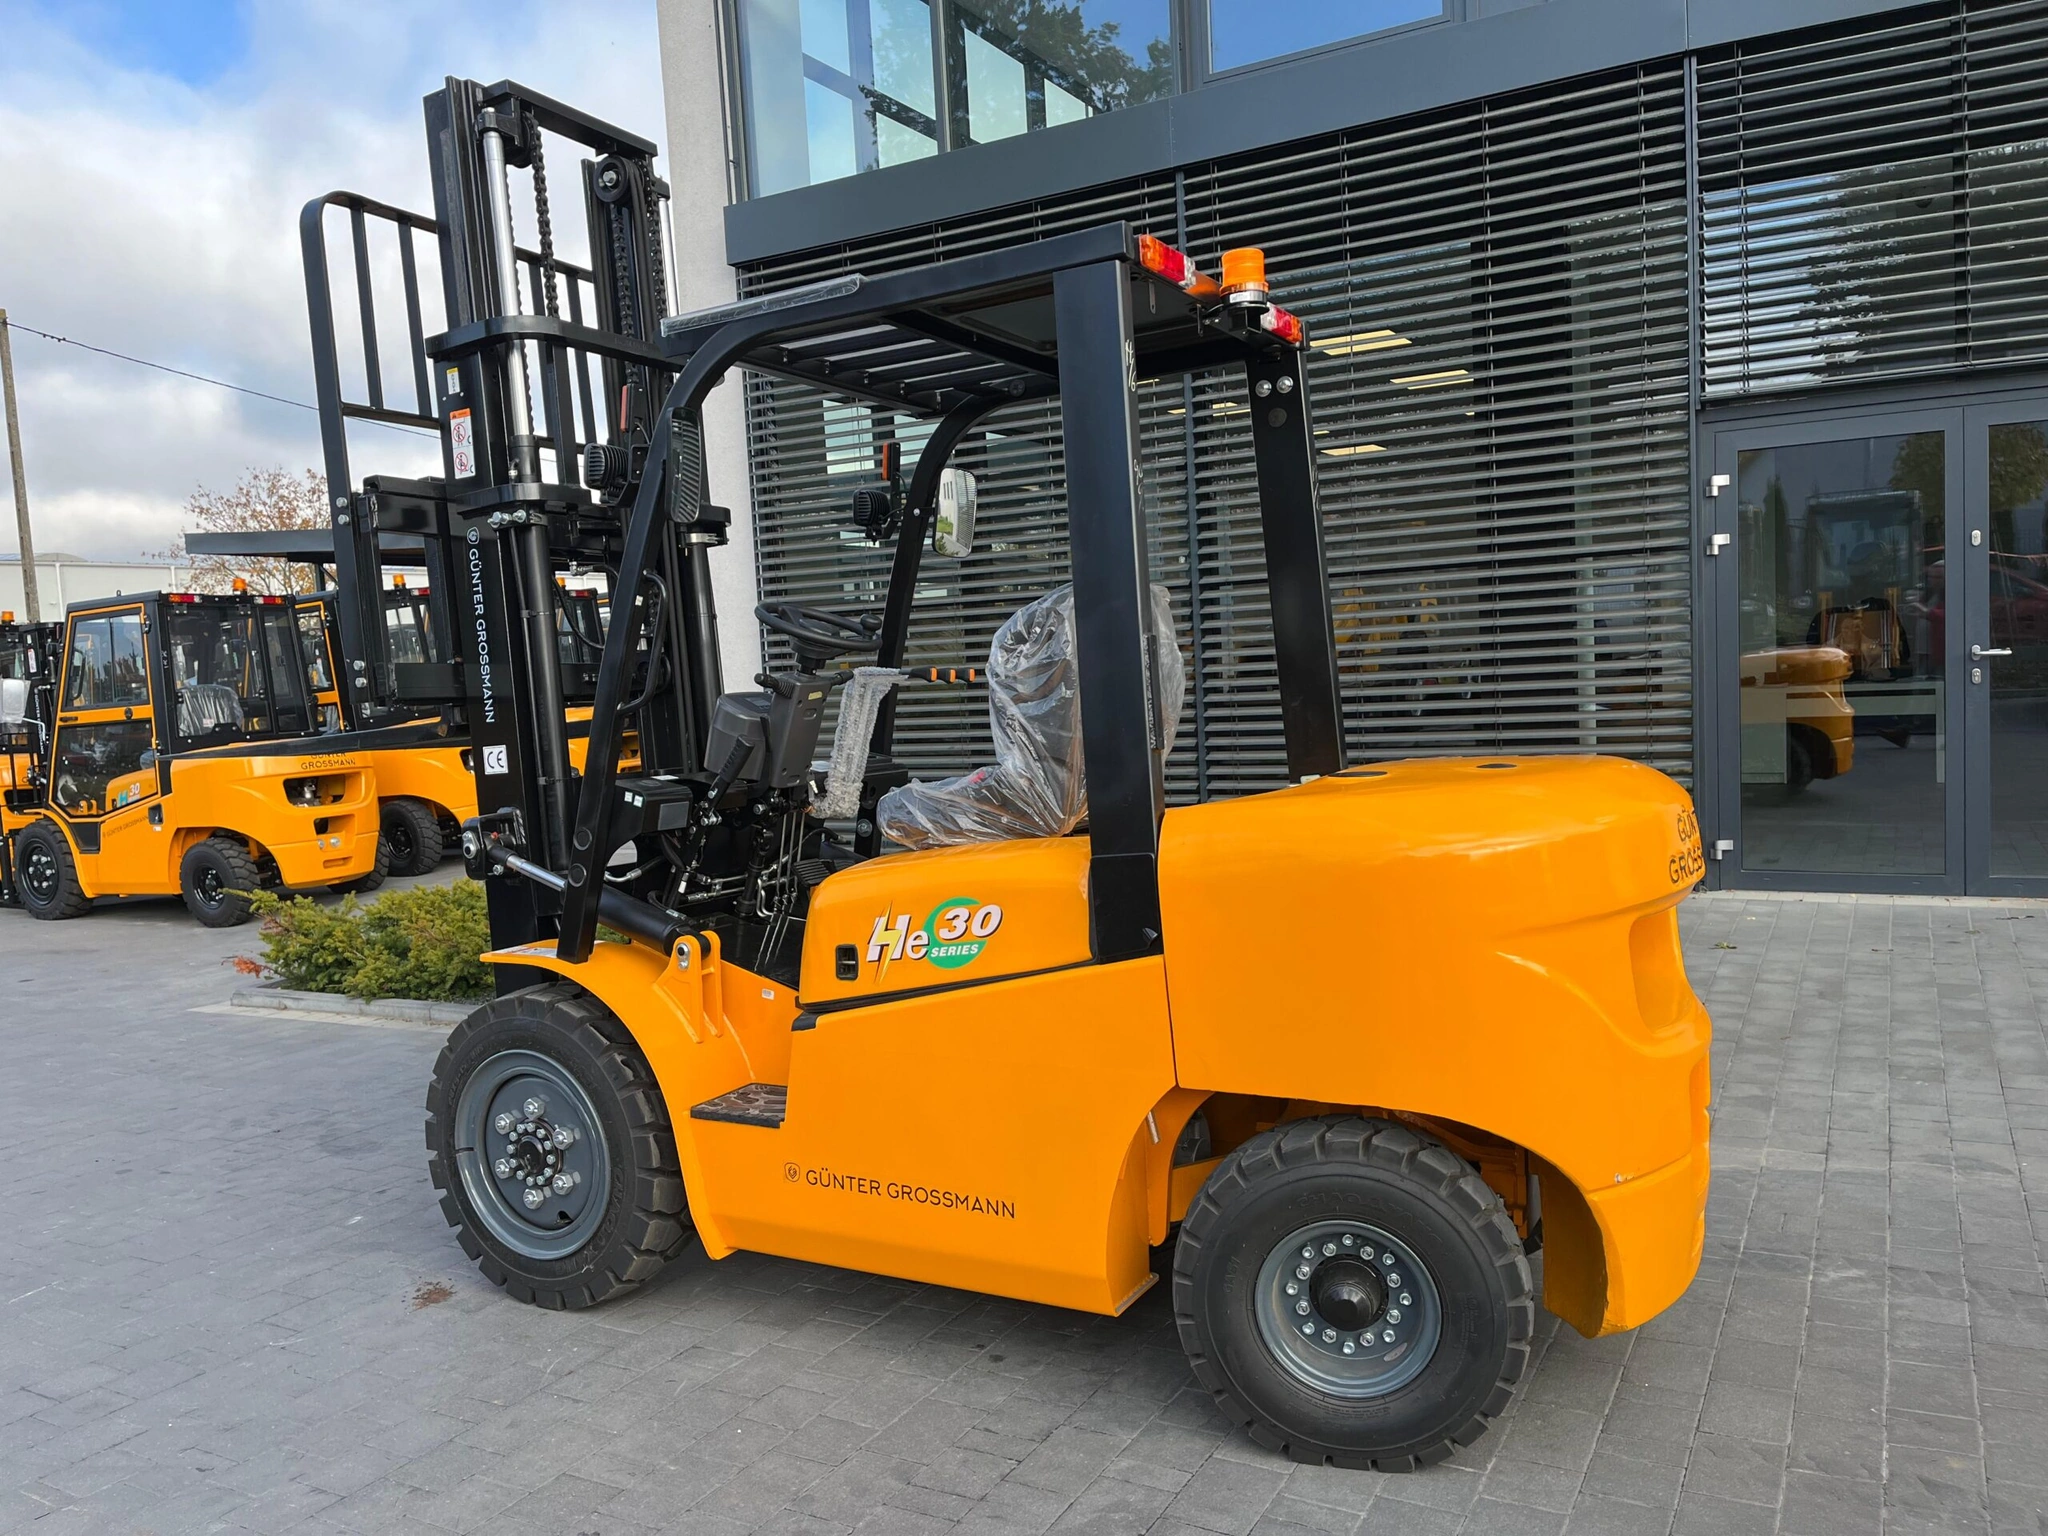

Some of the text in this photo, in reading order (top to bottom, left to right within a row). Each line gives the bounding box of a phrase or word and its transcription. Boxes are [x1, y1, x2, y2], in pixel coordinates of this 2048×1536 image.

[469, 547, 495, 724] GÜNTER GROSSMANN
[300, 758, 356, 770] GROSSMANN
[129, 782, 141, 796] 30
[865, 904, 1003, 962] He 30
[930, 943, 979, 958] SERIES
[805, 1167, 1016, 1219] GÜNTER GROSSMANN
